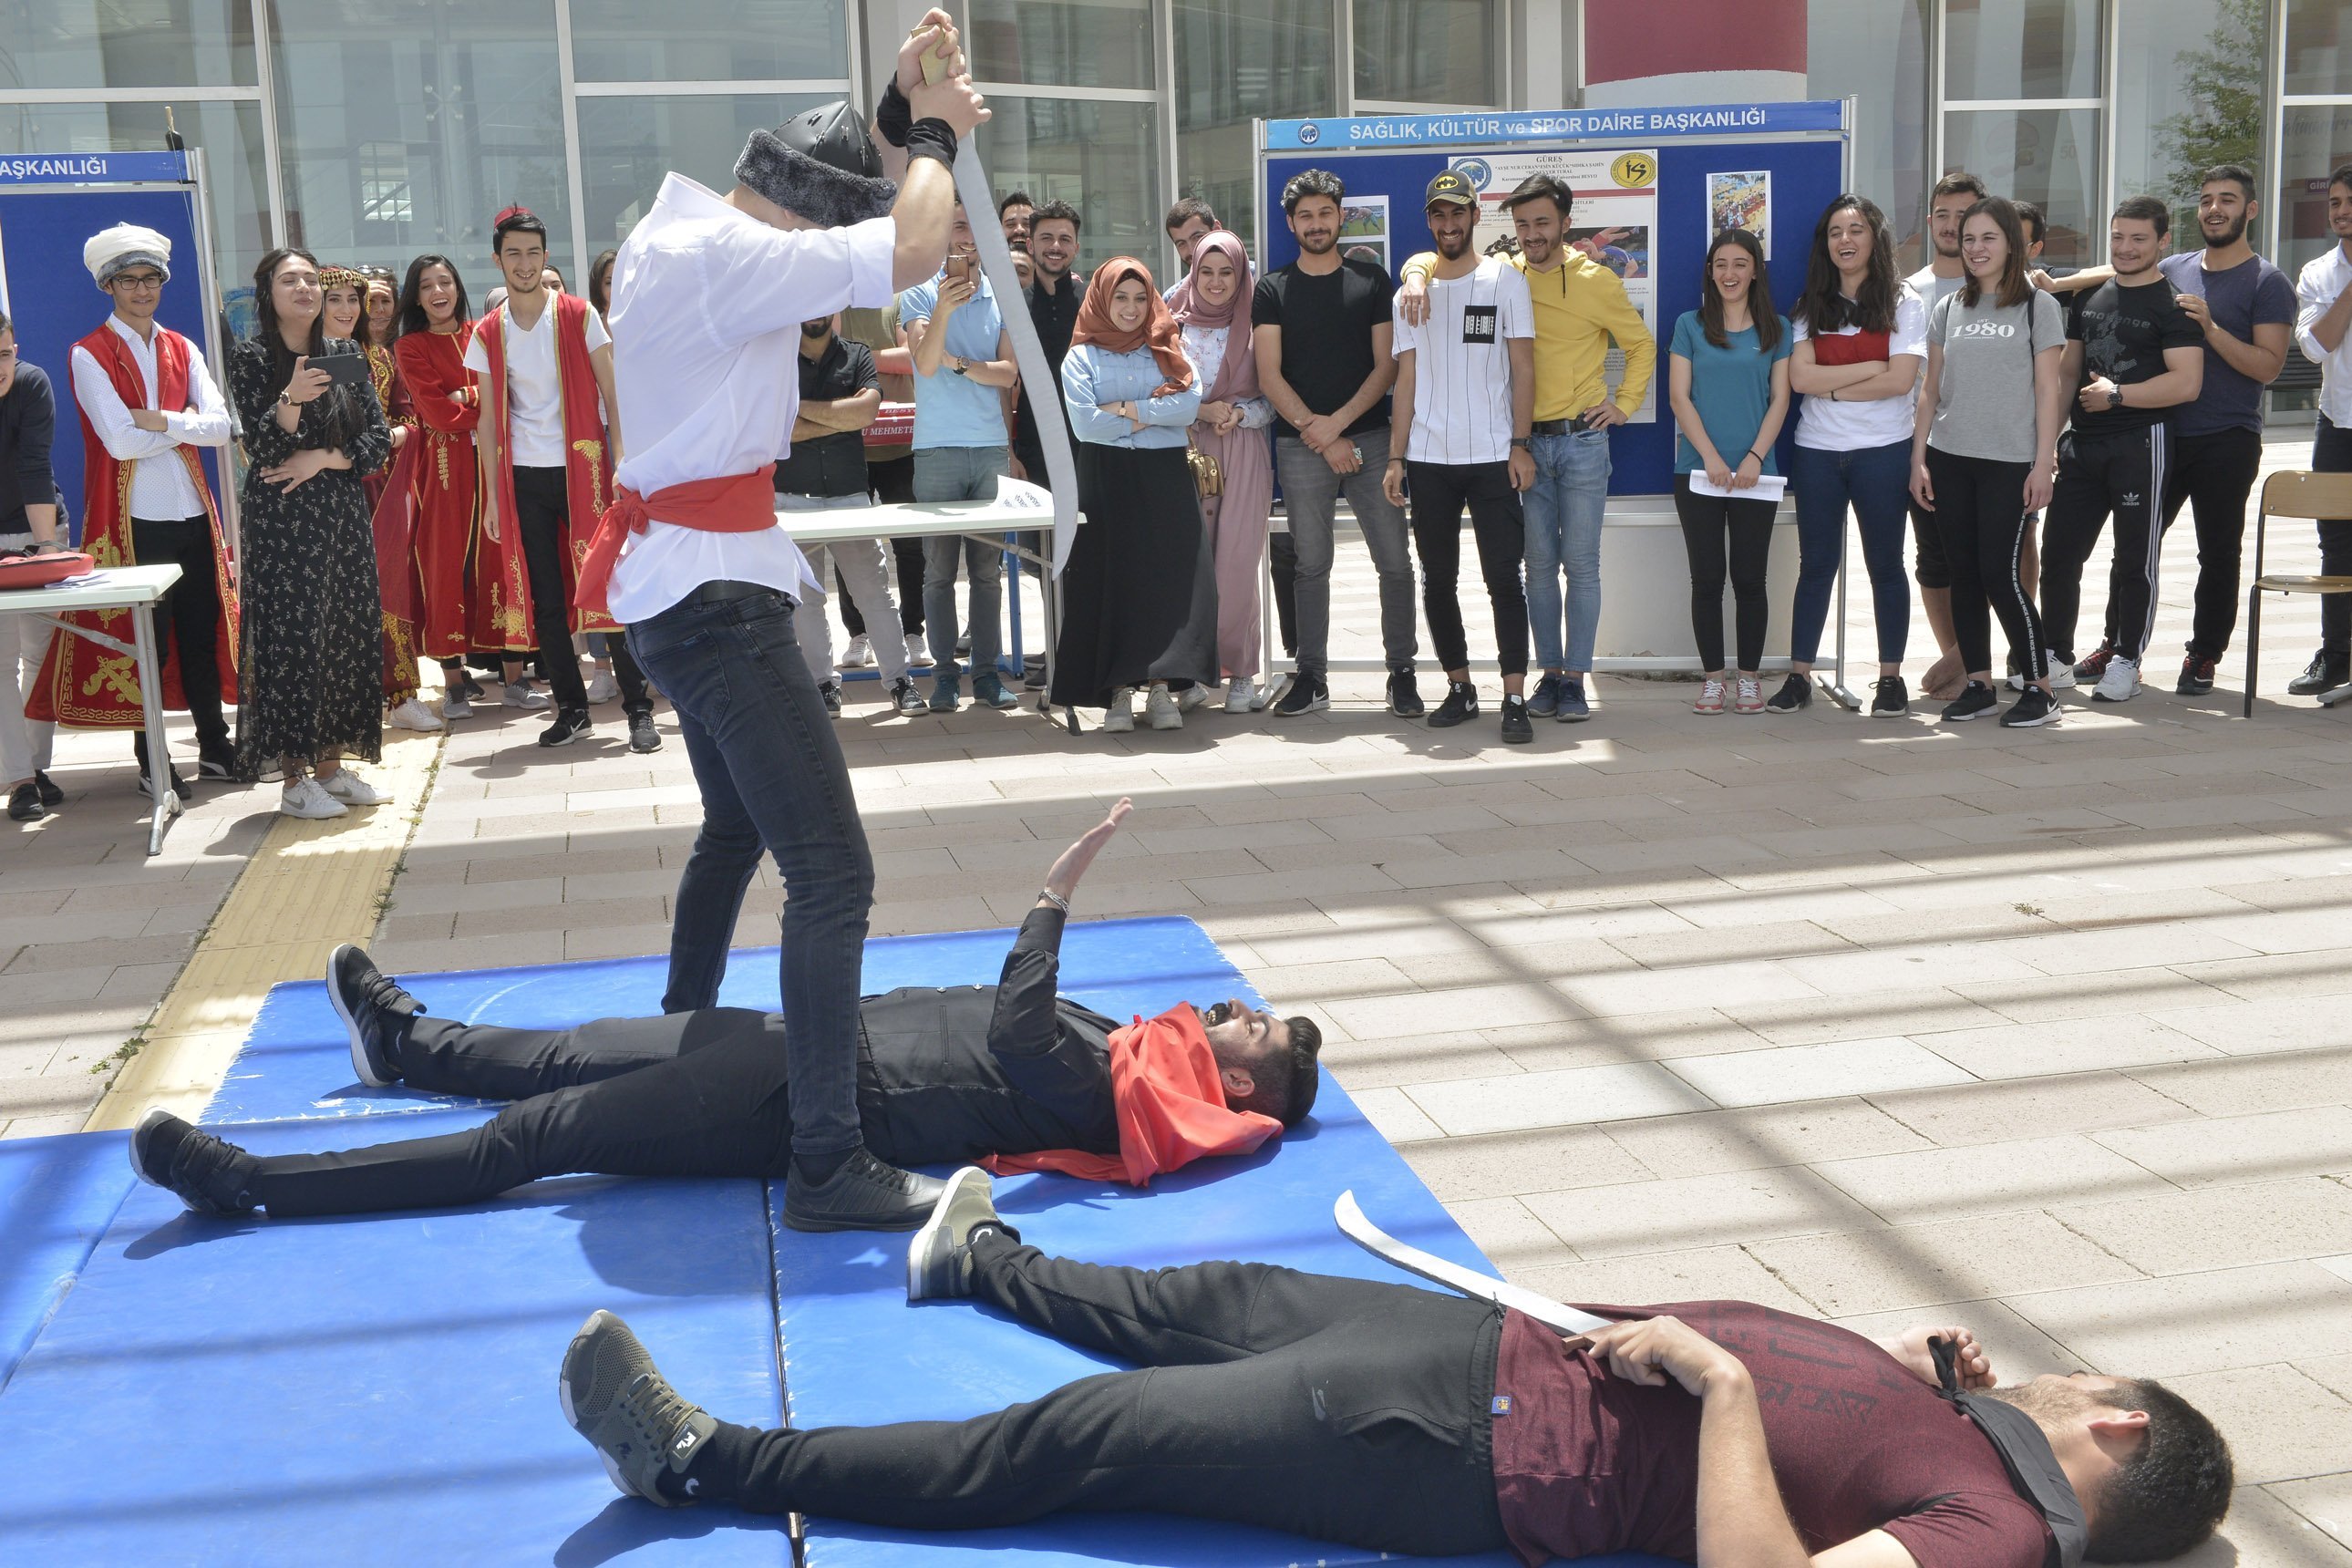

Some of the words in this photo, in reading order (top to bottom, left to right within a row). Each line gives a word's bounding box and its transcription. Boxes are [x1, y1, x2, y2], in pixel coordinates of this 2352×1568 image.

[1349, 121, 1422, 140] SAĞLIK,
[1428, 119, 1501, 137] KÜLTÜR
[1506, 121, 1526, 134] ve
[1531, 117, 1583, 134] SPOR
[1588, 113, 1645, 132] DAİRE
[1650, 106, 1766, 132] BAŞKANLIĞI
[1536, 155, 1563, 163] GÜREŞ
[1950, 322, 2015, 338] 1980
